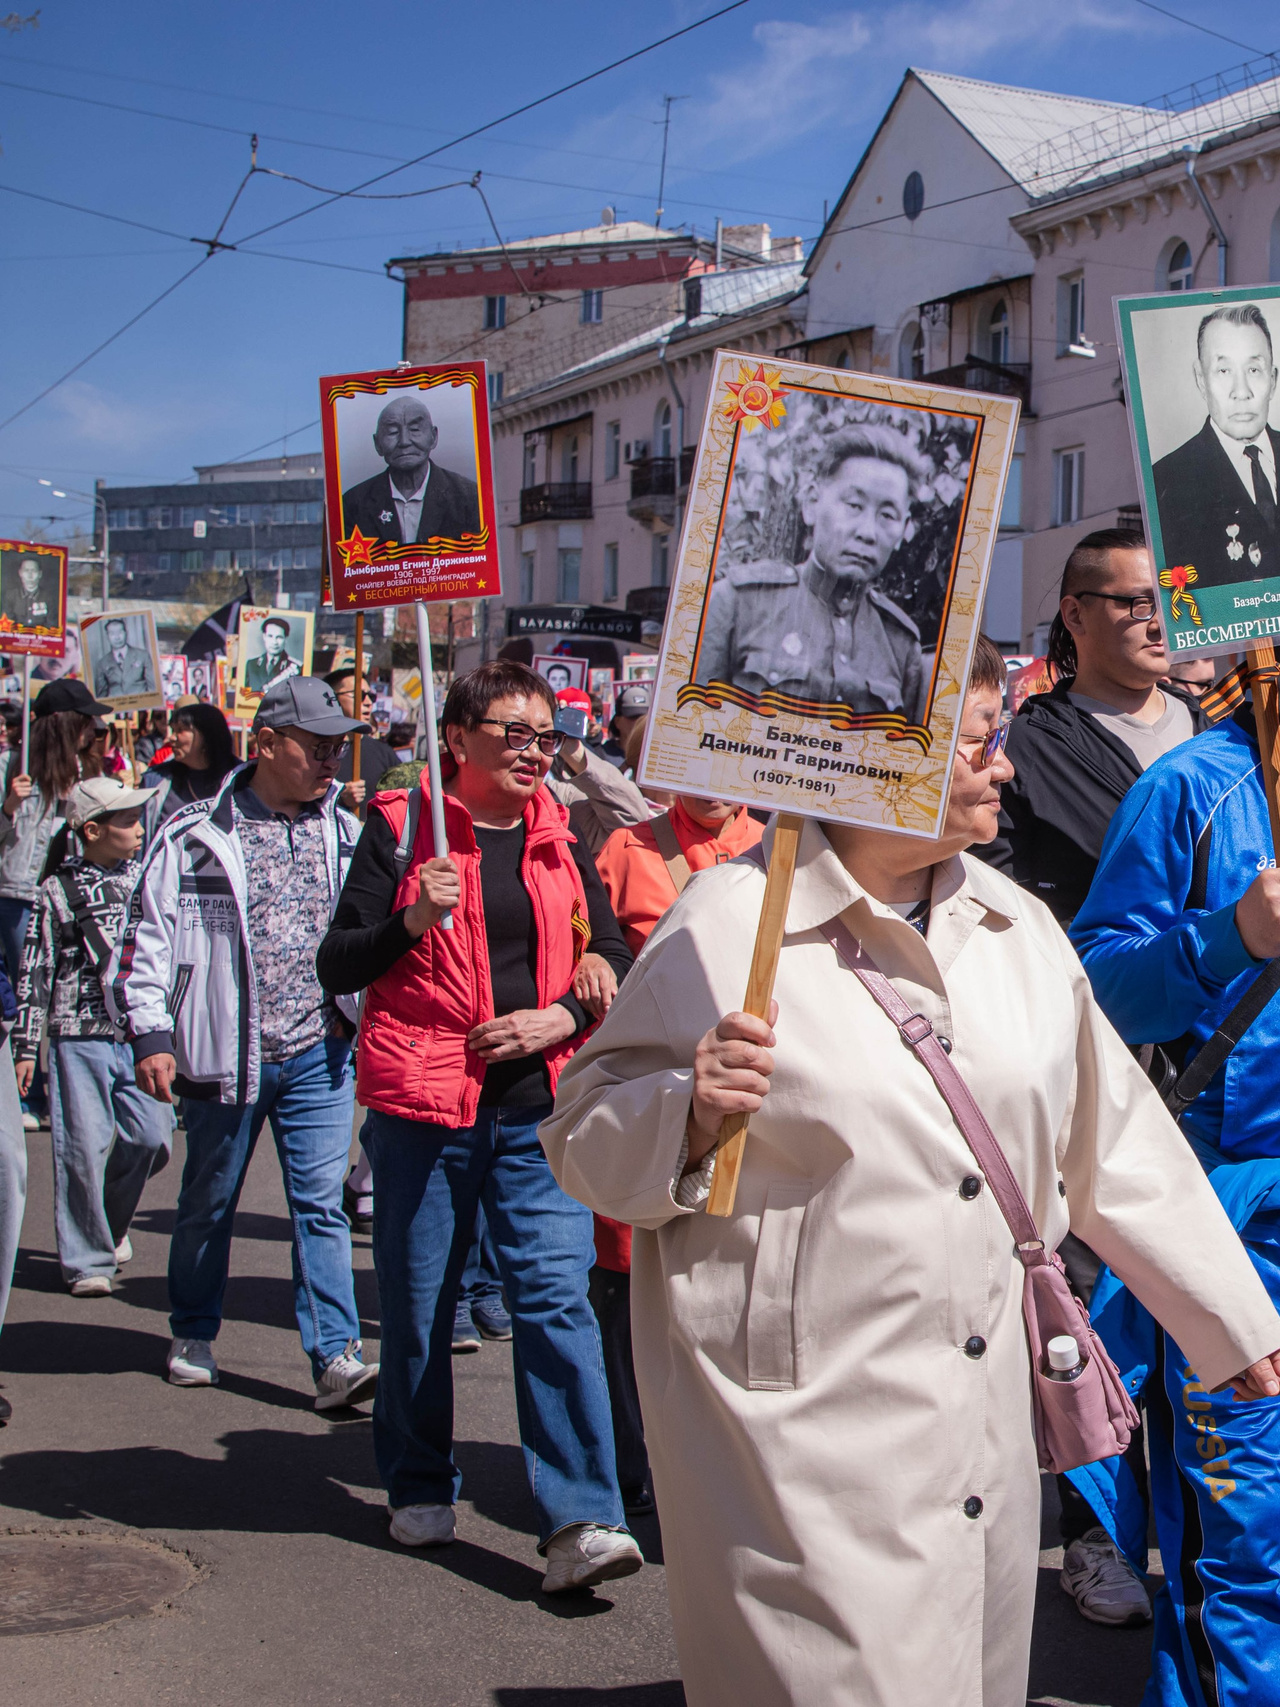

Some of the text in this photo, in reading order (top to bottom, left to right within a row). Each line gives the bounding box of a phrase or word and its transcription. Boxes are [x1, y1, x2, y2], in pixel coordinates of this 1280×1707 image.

[344, 554, 487, 578] Дымбрылов Егнин Доржиевич
[393, 570, 414, 580] 1906
[421, 567, 441, 577] 1997
[365, 580, 469, 601] БЕССМЕРТНЫЙ ПОЛК
[386, 578, 412, 588] ВОЕВАЛ
[412, 577, 427, 585] ПОД
[428, 572, 476, 583] ЛЕНИНГРАДОМ
[519, 617, 634, 633] BAYASKHALANOV
[766, 725, 843, 753] Бажеев
[699, 732, 904, 783] Даниил Гаврилович
[753, 769, 836, 797] (1907-1981)
[179, 897, 210, 908] CAMP
[182, 908, 217, 916] COMPETITIVE
[125, 893, 143, 941] CMPD
[183, 919, 235, 933] JF-19-63
[1183, 1365, 1237, 1504] USSIA
